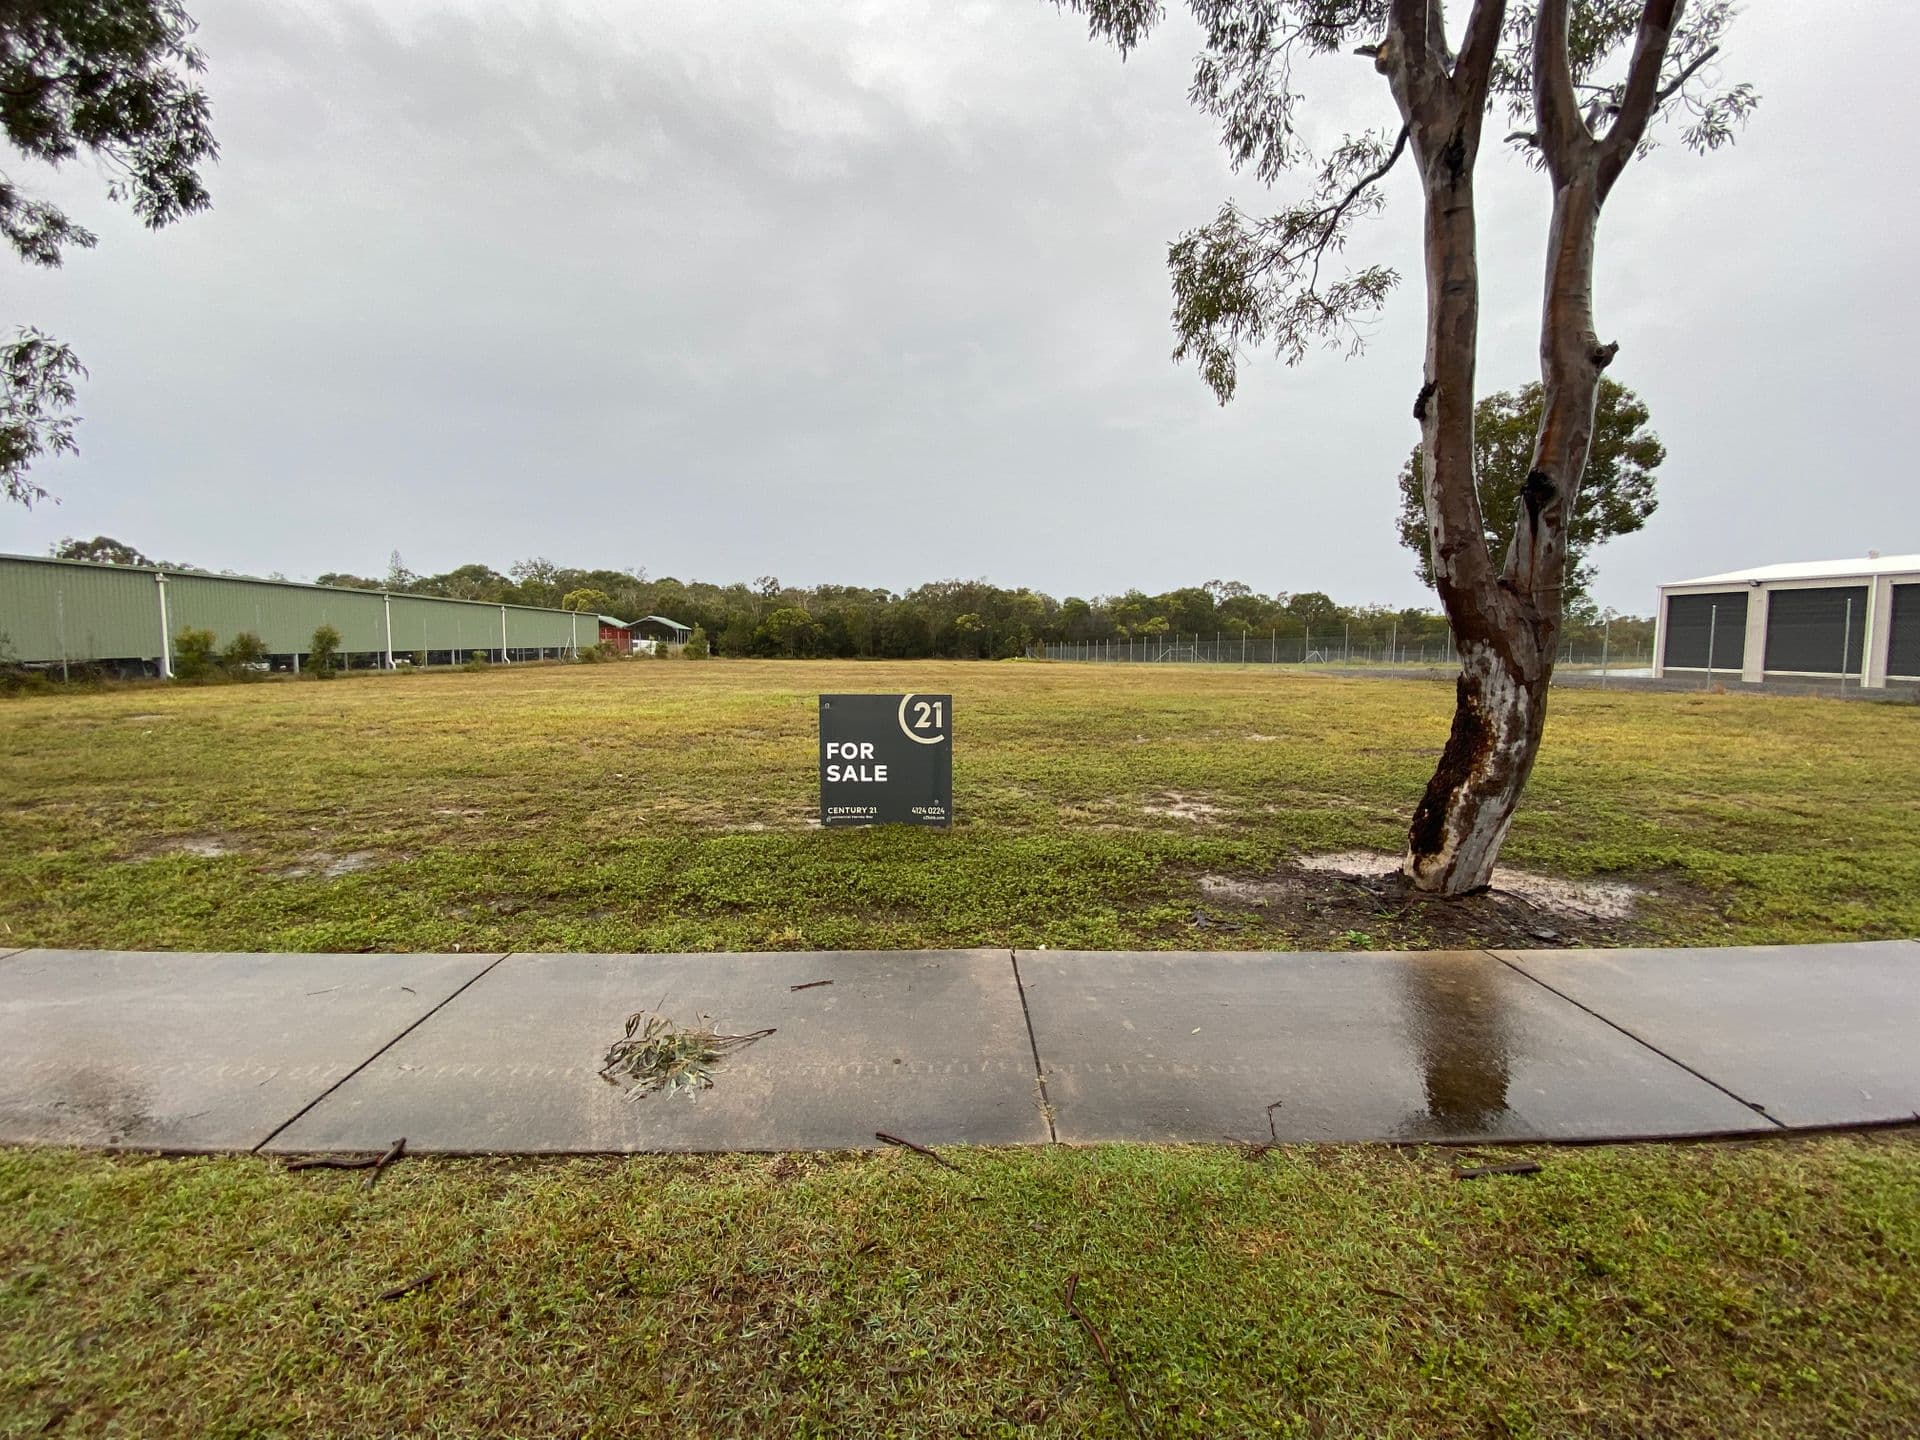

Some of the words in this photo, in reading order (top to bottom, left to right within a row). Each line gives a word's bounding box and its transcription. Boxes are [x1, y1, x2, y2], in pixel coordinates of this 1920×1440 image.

[826, 742, 874, 760] FOR
[826, 765, 888, 782] SALE
[827, 806, 868, 814] CENTURY
[869, 806, 877, 814] 21
[927, 806, 945, 815] 0224
